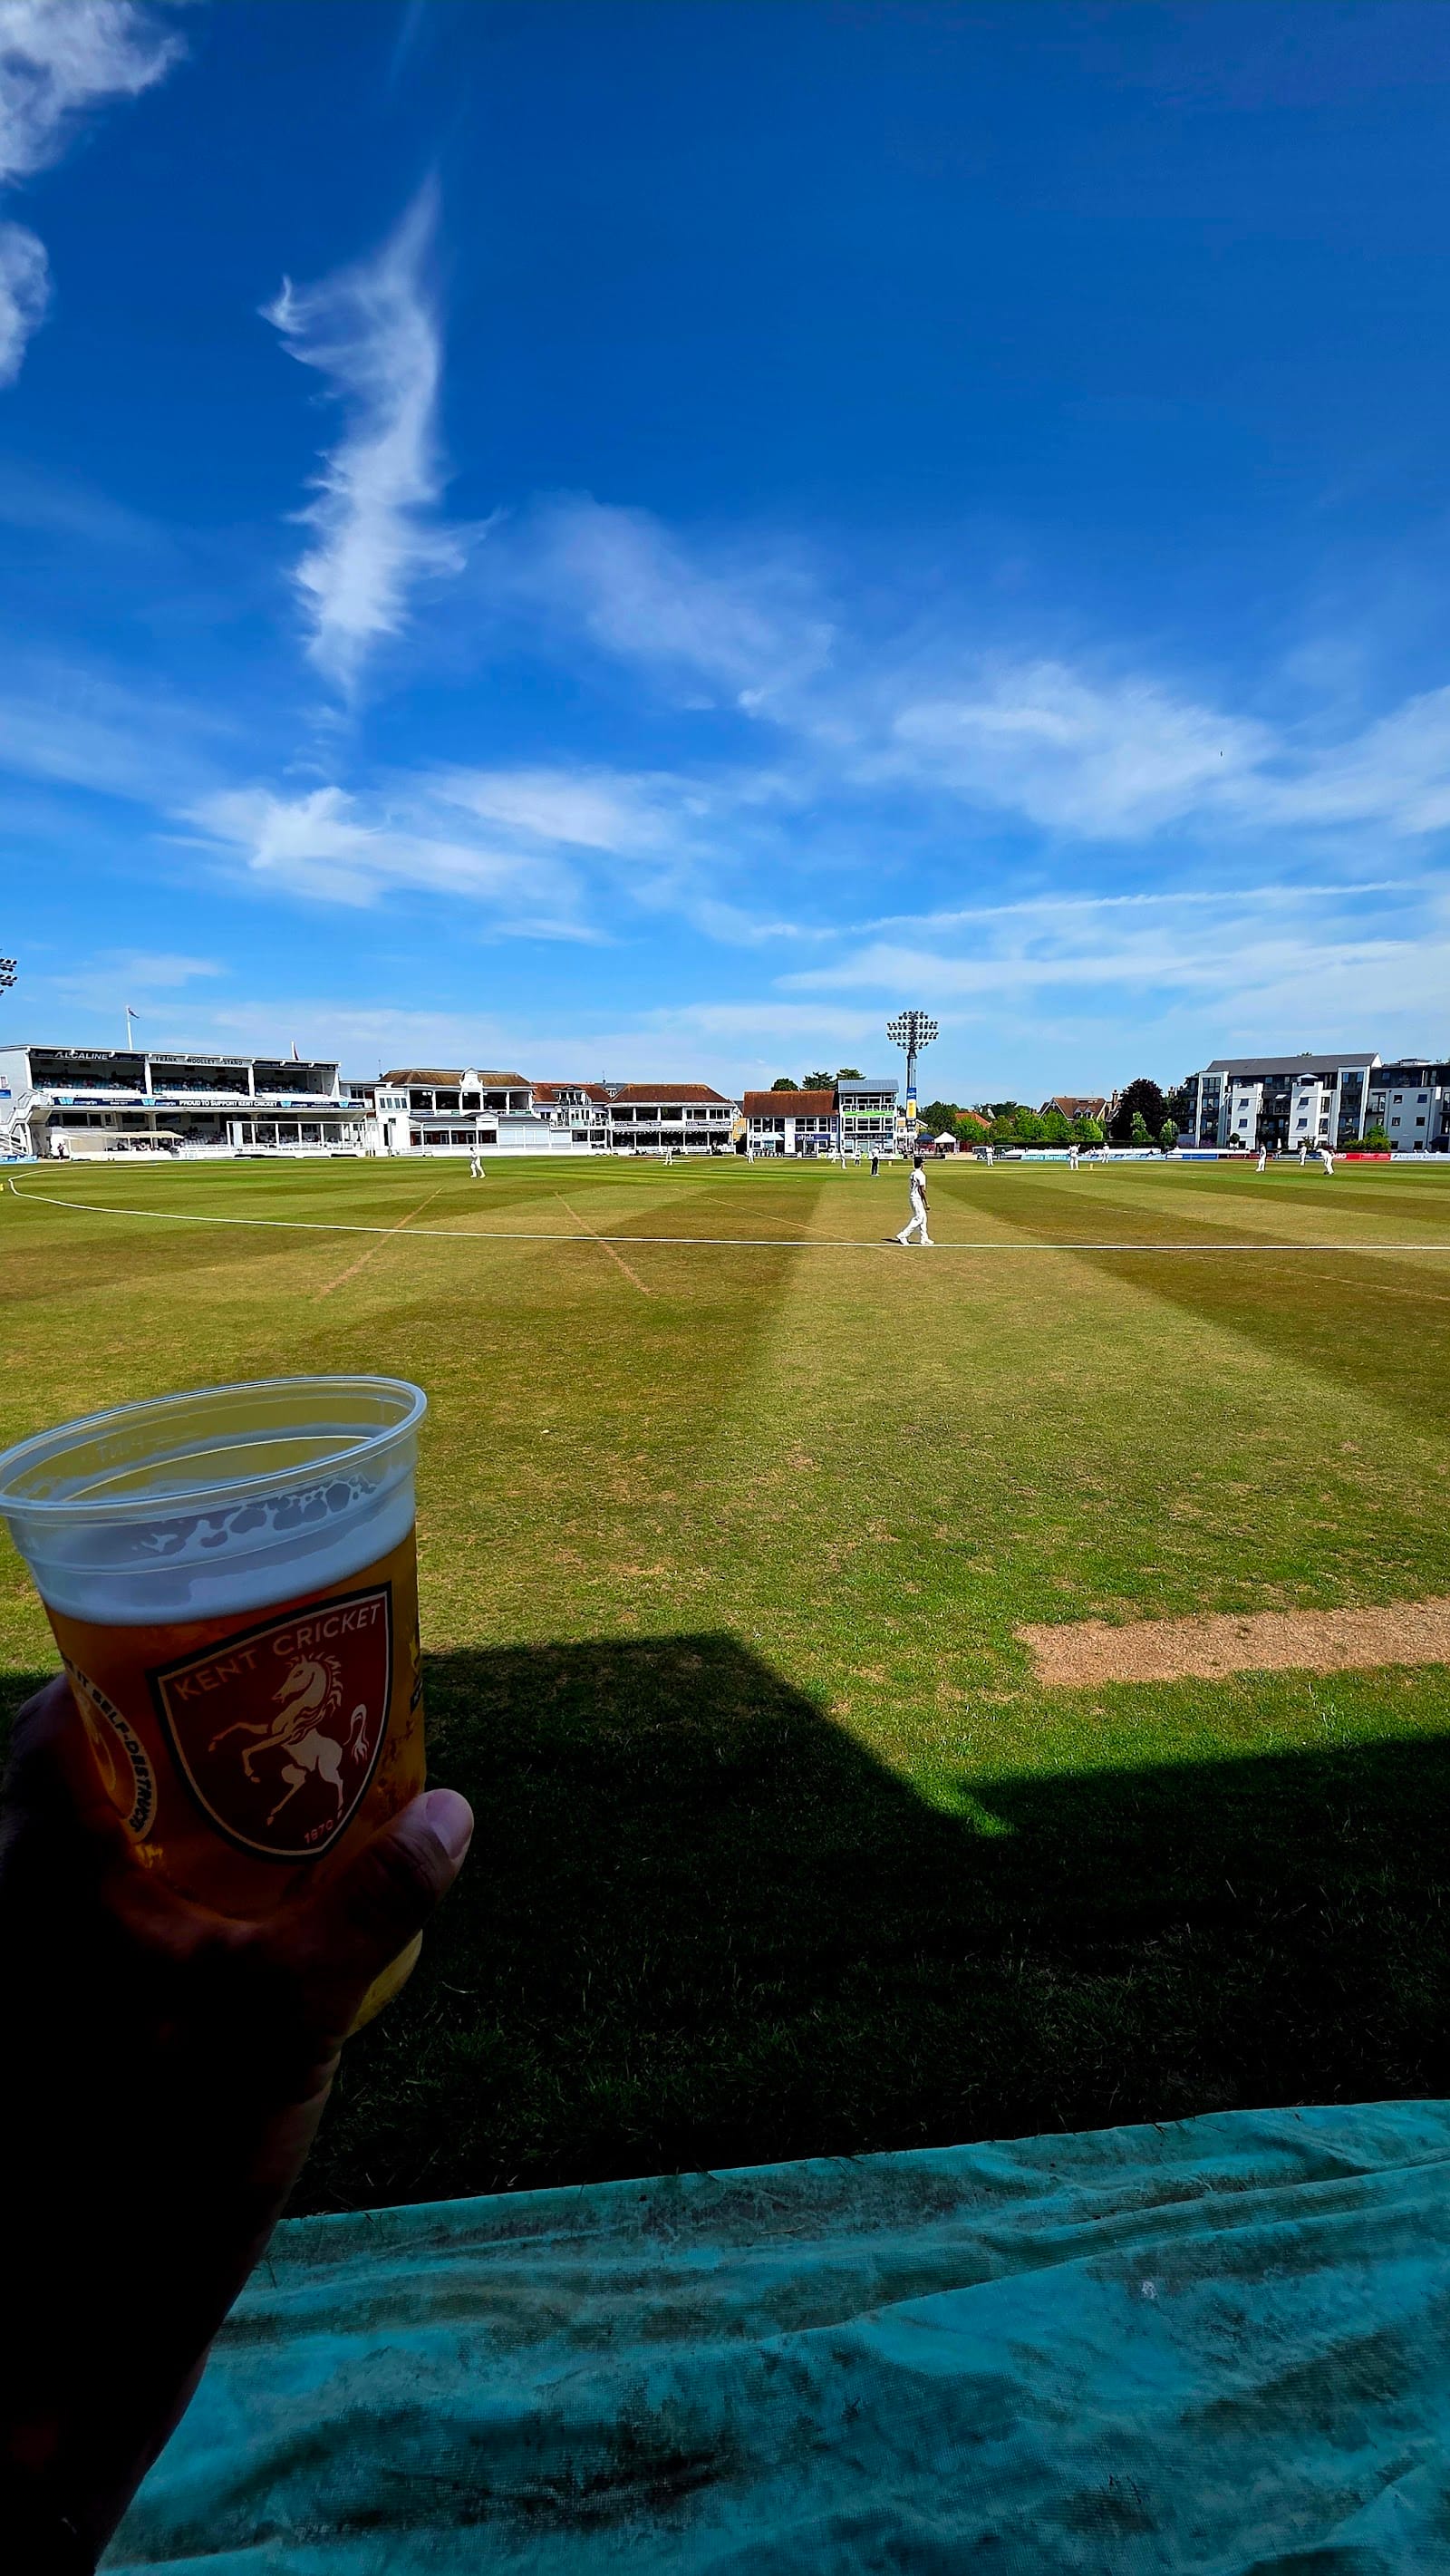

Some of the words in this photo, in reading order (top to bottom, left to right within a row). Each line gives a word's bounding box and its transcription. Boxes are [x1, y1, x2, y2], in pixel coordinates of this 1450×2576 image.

[54, 1051, 109, 1060] ALCALINE
[174, 1649, 258, 1700] KENT
[273, 1603, 381, 1656] CRICKET
[304, 1819, 334, 1845] 1870
